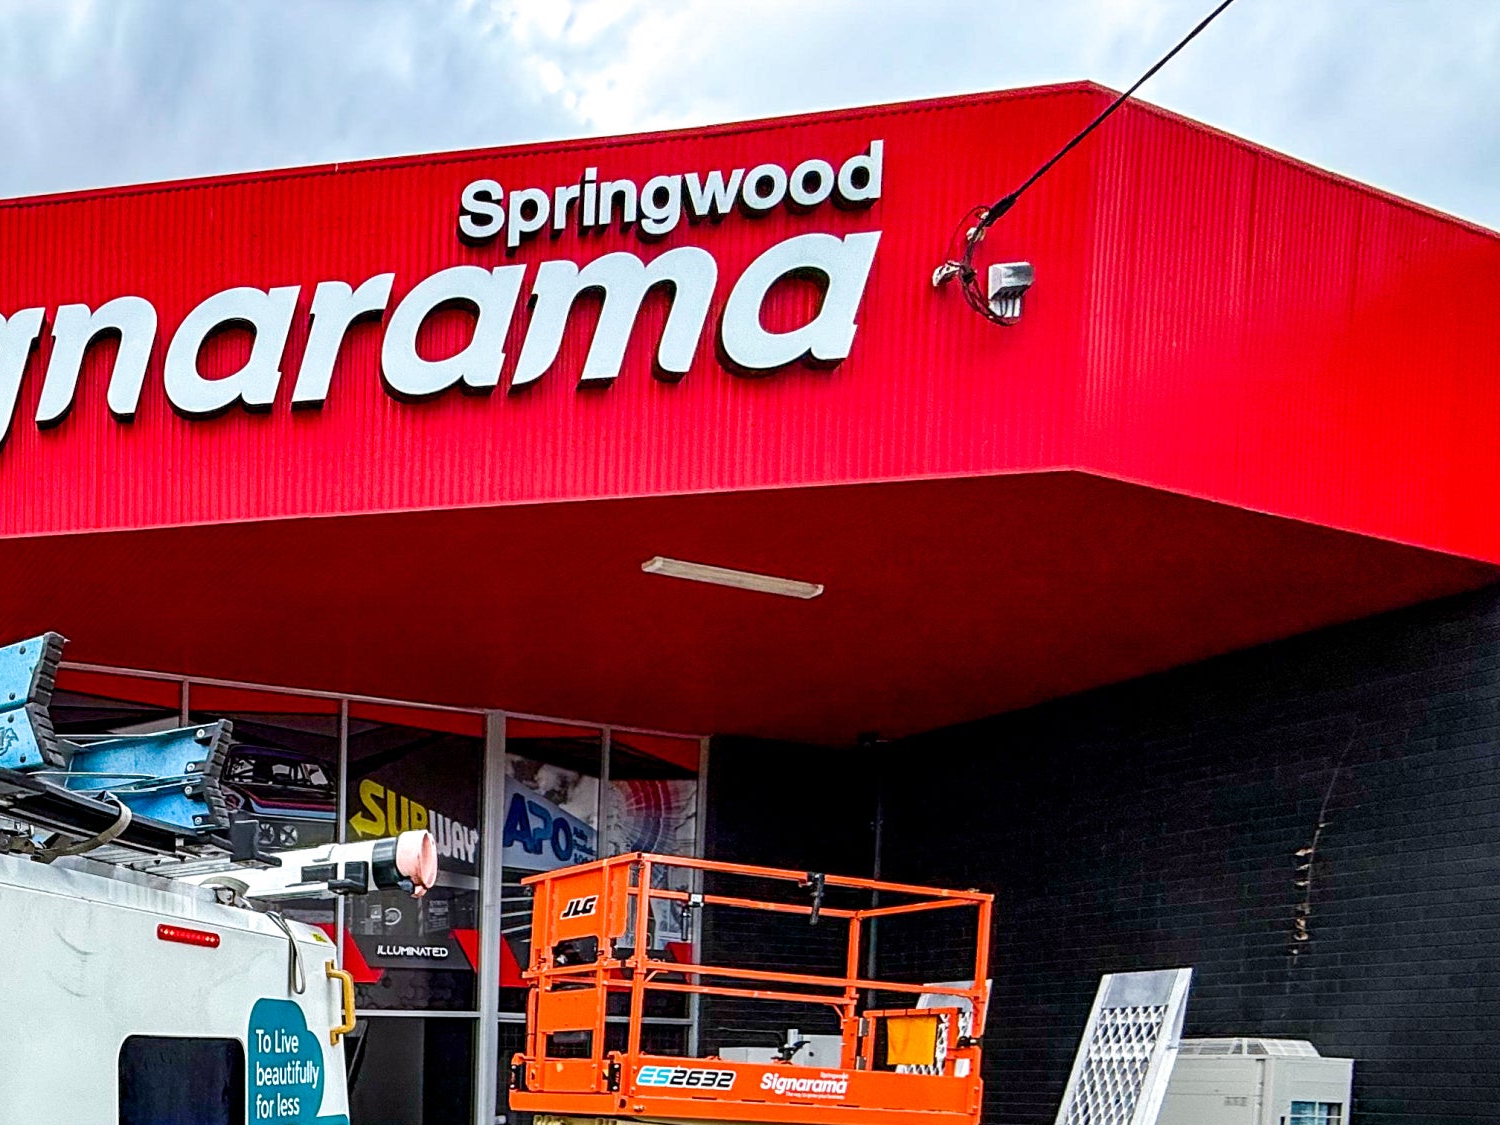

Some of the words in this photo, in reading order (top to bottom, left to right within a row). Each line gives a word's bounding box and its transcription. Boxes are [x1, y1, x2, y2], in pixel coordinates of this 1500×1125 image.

[459, 138, 885, 248] Springwood
[561, 896, 598, 919] JLG
[377, 944, 448, 958] ILLUMINATED
[255, 1028, 272, 1053] To
[275, 1028, 299, 1053] Live
[256, 1060, 320, 1089] beautifully
[638, 1067, 734, 1088] ES2632
[760, 1072, 847, 1094] Signarama
[256, 1093, 274, 1119] for
[277, 1093, 300, 1116] less
